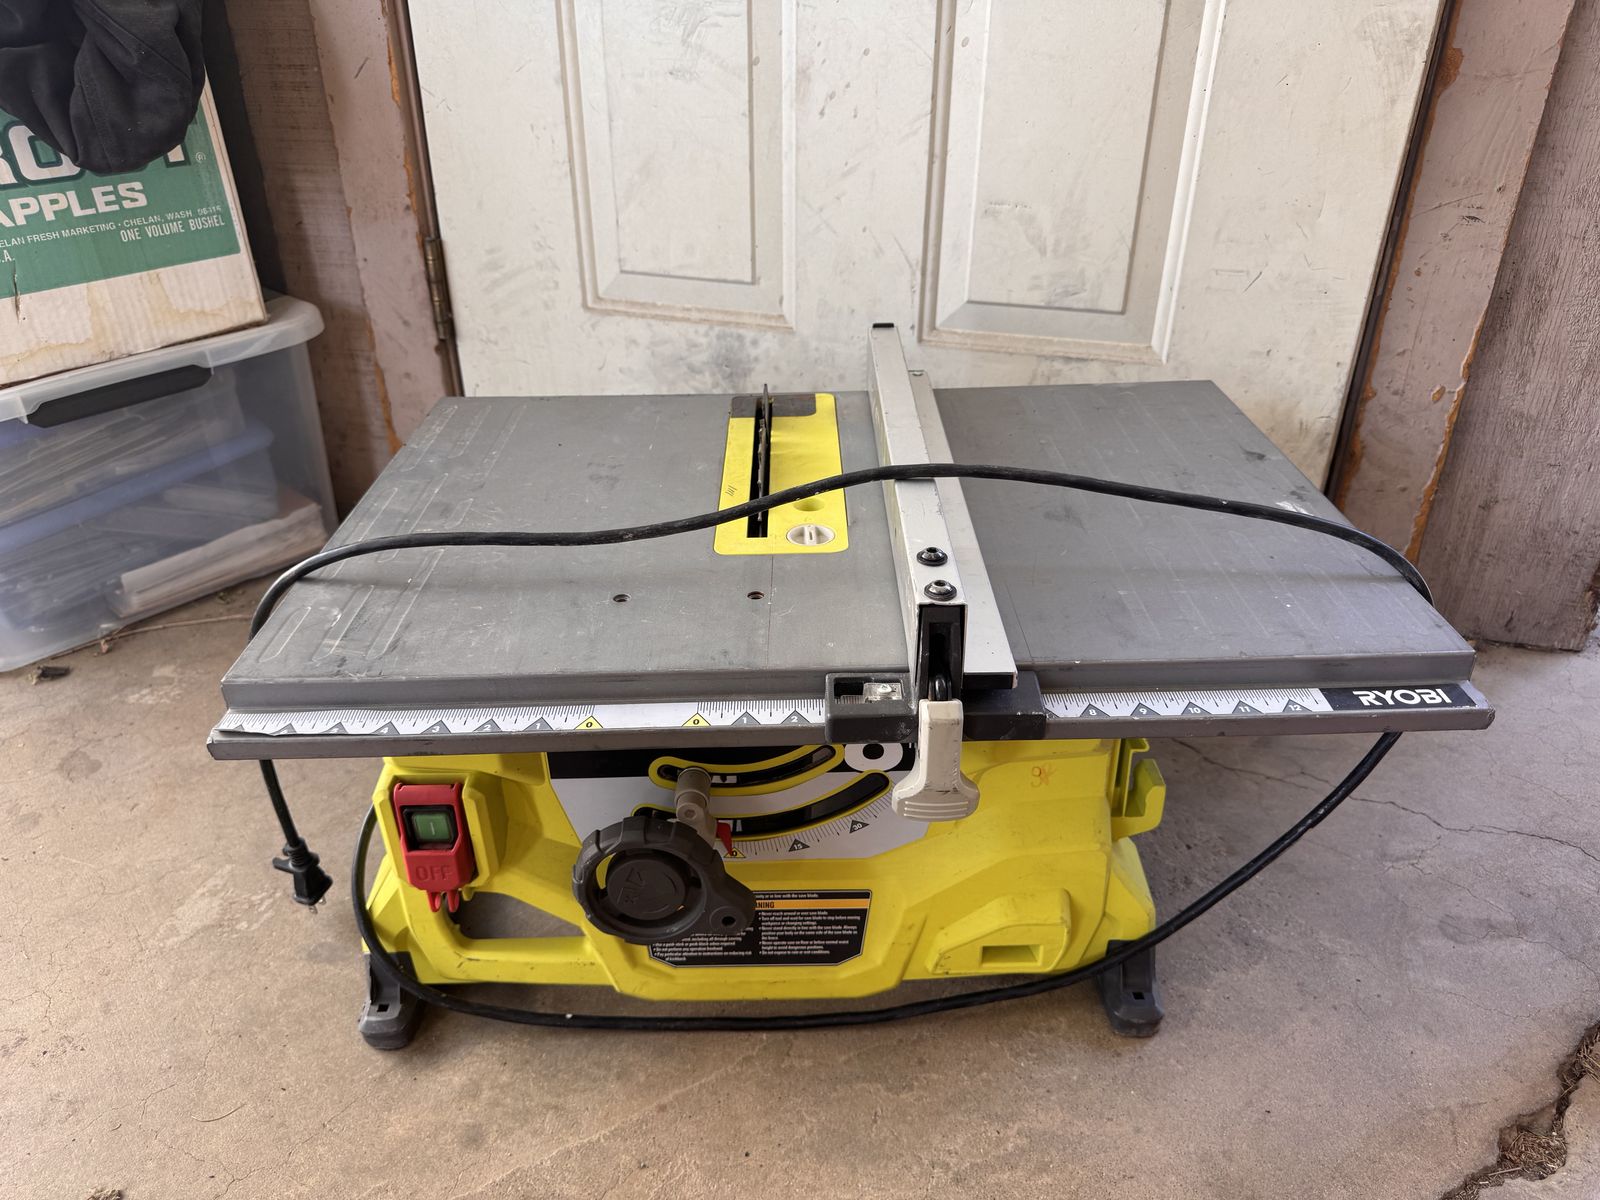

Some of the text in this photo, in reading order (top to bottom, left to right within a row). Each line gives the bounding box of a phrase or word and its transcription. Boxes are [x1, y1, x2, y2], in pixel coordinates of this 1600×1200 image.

[27, 231, 60, 244] FRESH
[61, 222, 116, 238] MARKETING
[120, 213, 225, 243] ONE VOLUME BUSHEL
[1352, 688, 1452, 706] RYOBI
[416, 865, 453, 881] OFF
